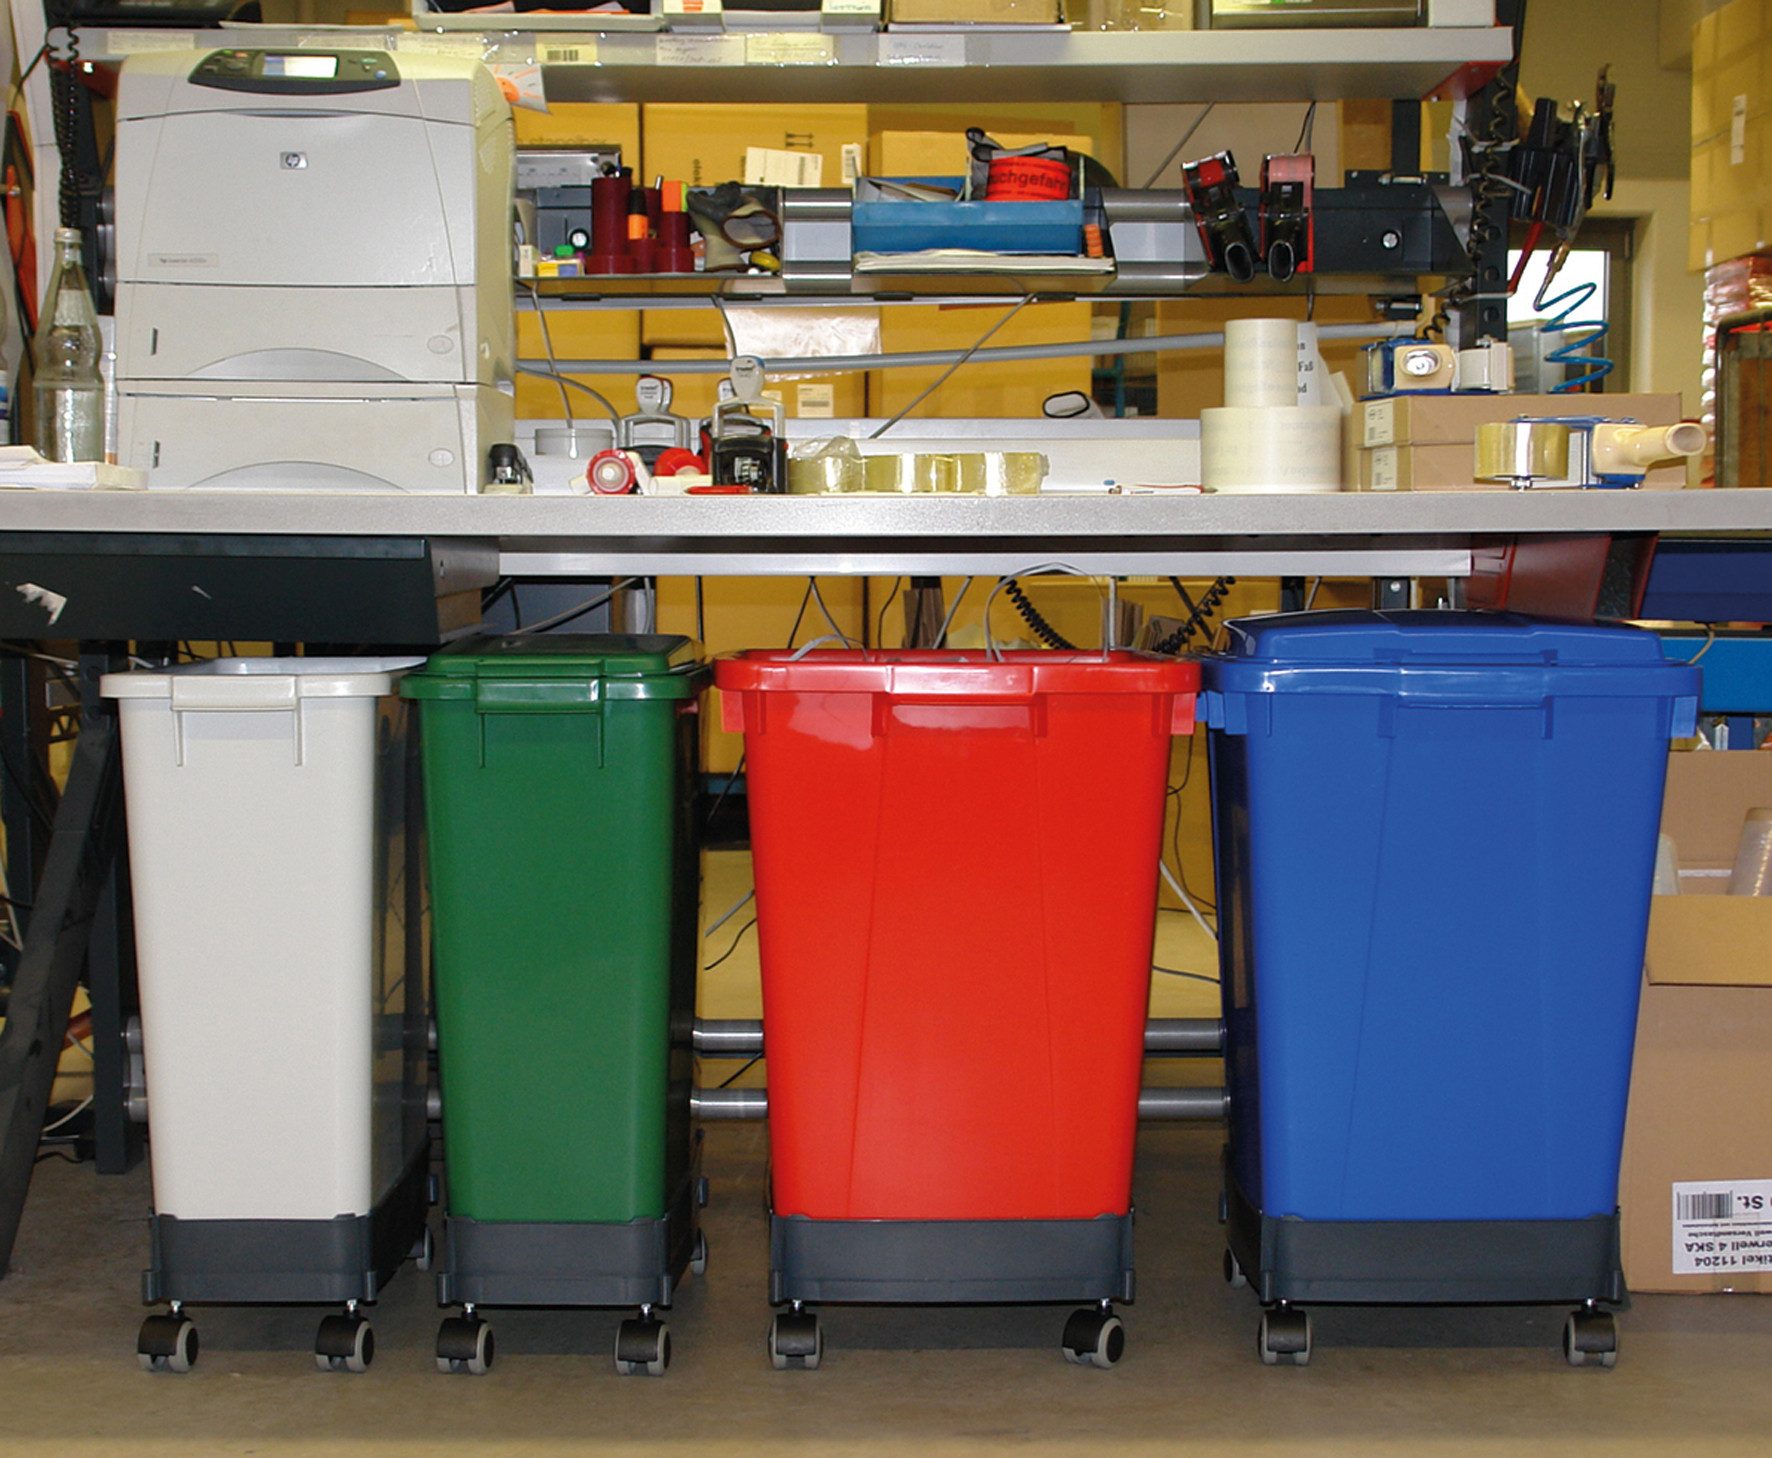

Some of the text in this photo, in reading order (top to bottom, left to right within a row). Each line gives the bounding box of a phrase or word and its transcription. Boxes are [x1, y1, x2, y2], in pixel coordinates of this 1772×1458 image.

[1736, 1195, 1764, 1209] St.
[1684, 1241, 1714, 1253] SKA
[1718, 1242, 1727, 1252] 4
[1694, 1255, 1737, 1267] 11204
